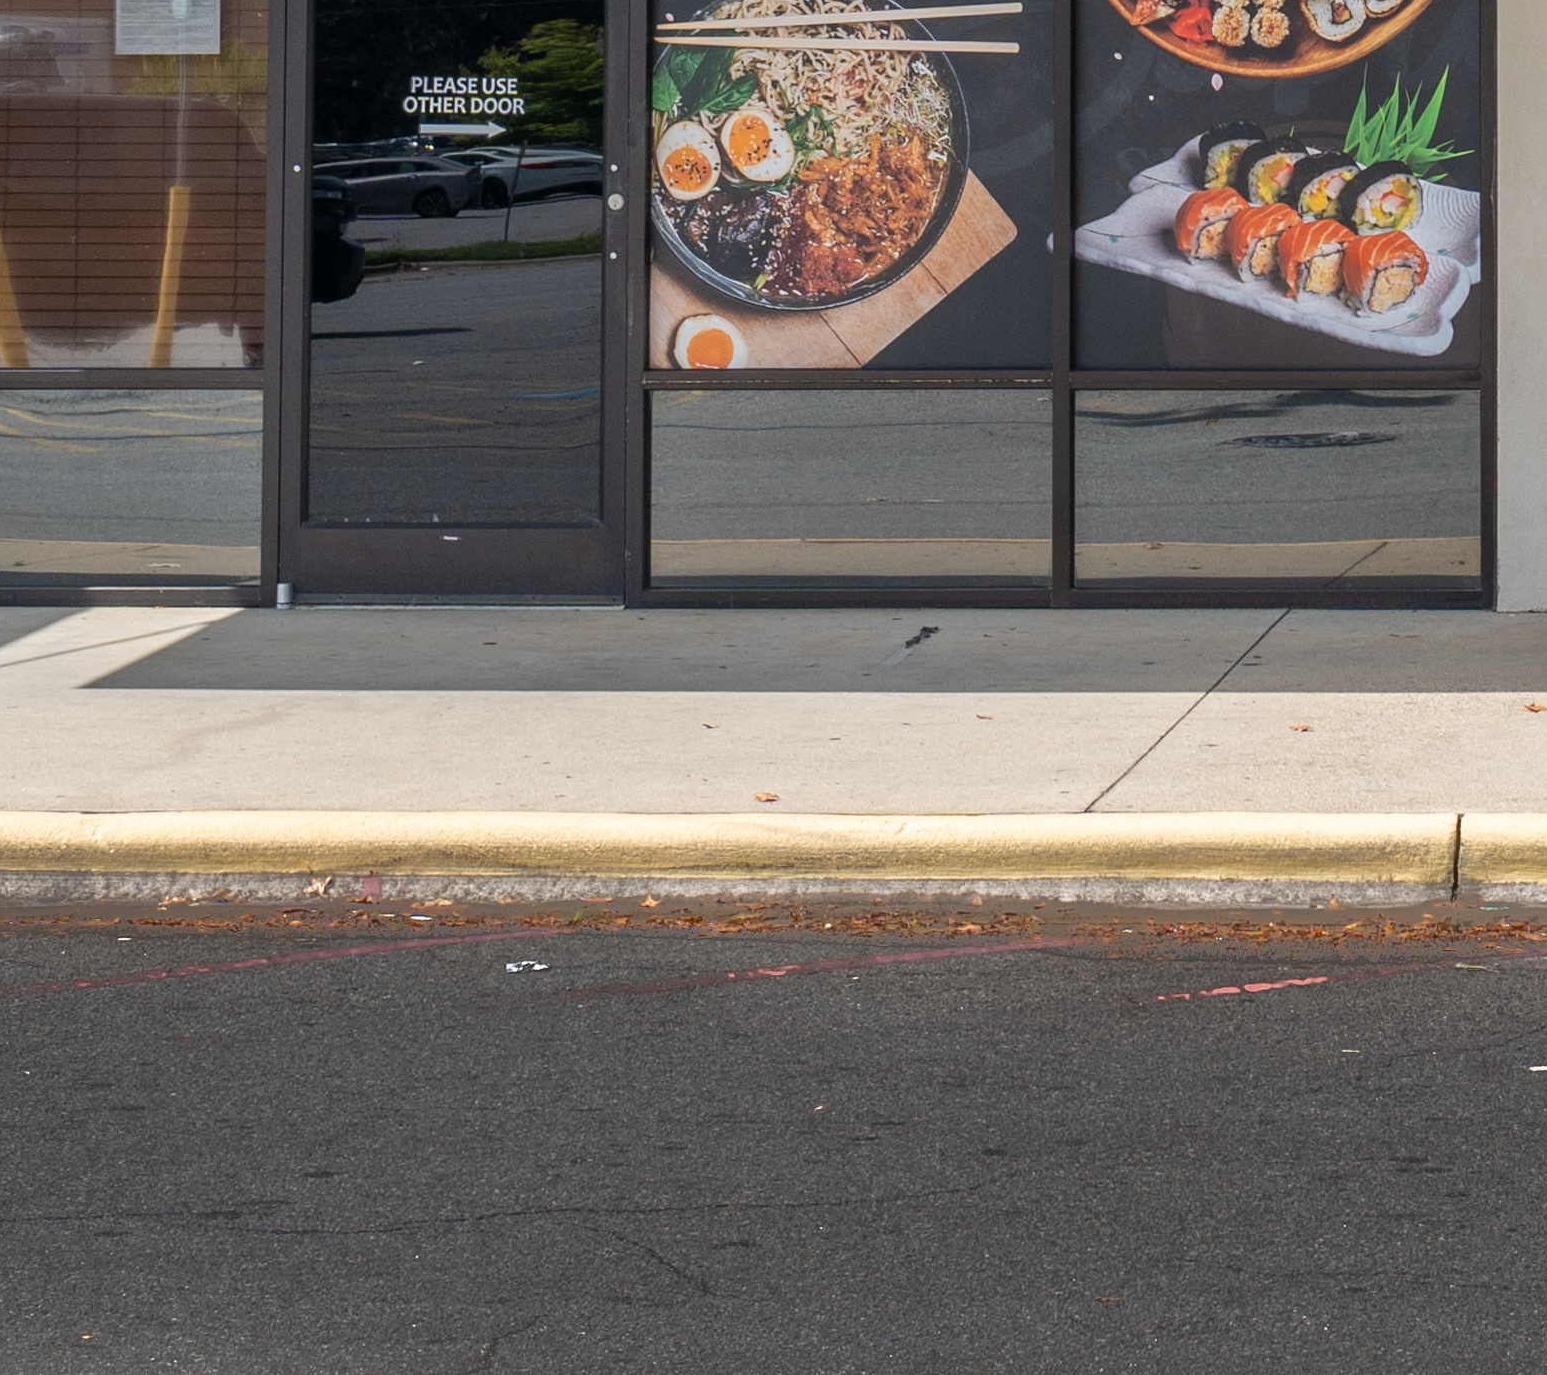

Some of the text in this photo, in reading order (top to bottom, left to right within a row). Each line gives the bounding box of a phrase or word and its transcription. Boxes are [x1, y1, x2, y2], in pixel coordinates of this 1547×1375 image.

[411, 76, 518, 95] PLEASE USE
[403, 96, 525, 115] OTHER DOOR
